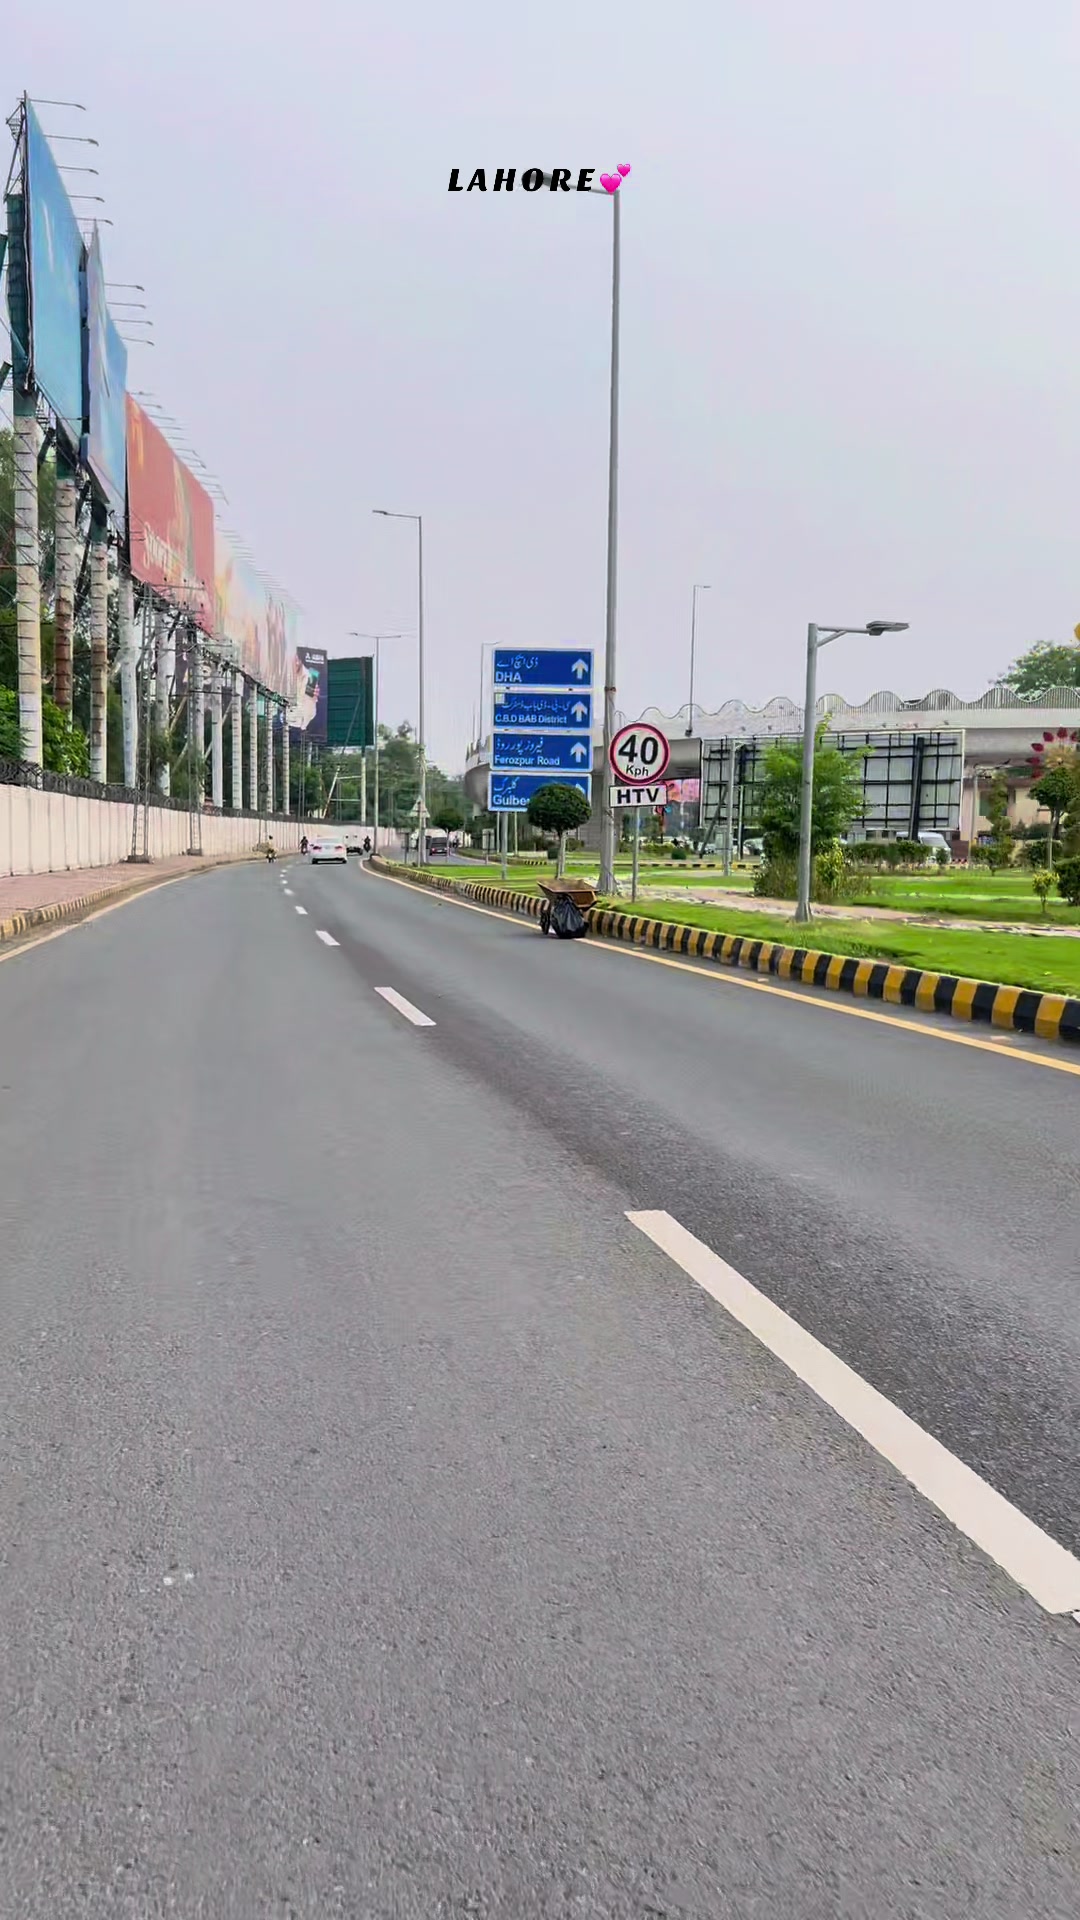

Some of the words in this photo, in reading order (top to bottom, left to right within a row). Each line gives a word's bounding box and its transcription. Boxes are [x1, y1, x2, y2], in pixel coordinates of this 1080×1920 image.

[495, 671, 522, 682] DHA
[518, 714, 537, 723] BAB
[538, 715, 567, 724] District
[618, 734, 658, 765] 40
[495, 755, 535, 767] Ferozpur
[537, 756, 560, 766] Road
[626, 764, 649, 777] Kph
[617, 788, 659, 804] HTV
